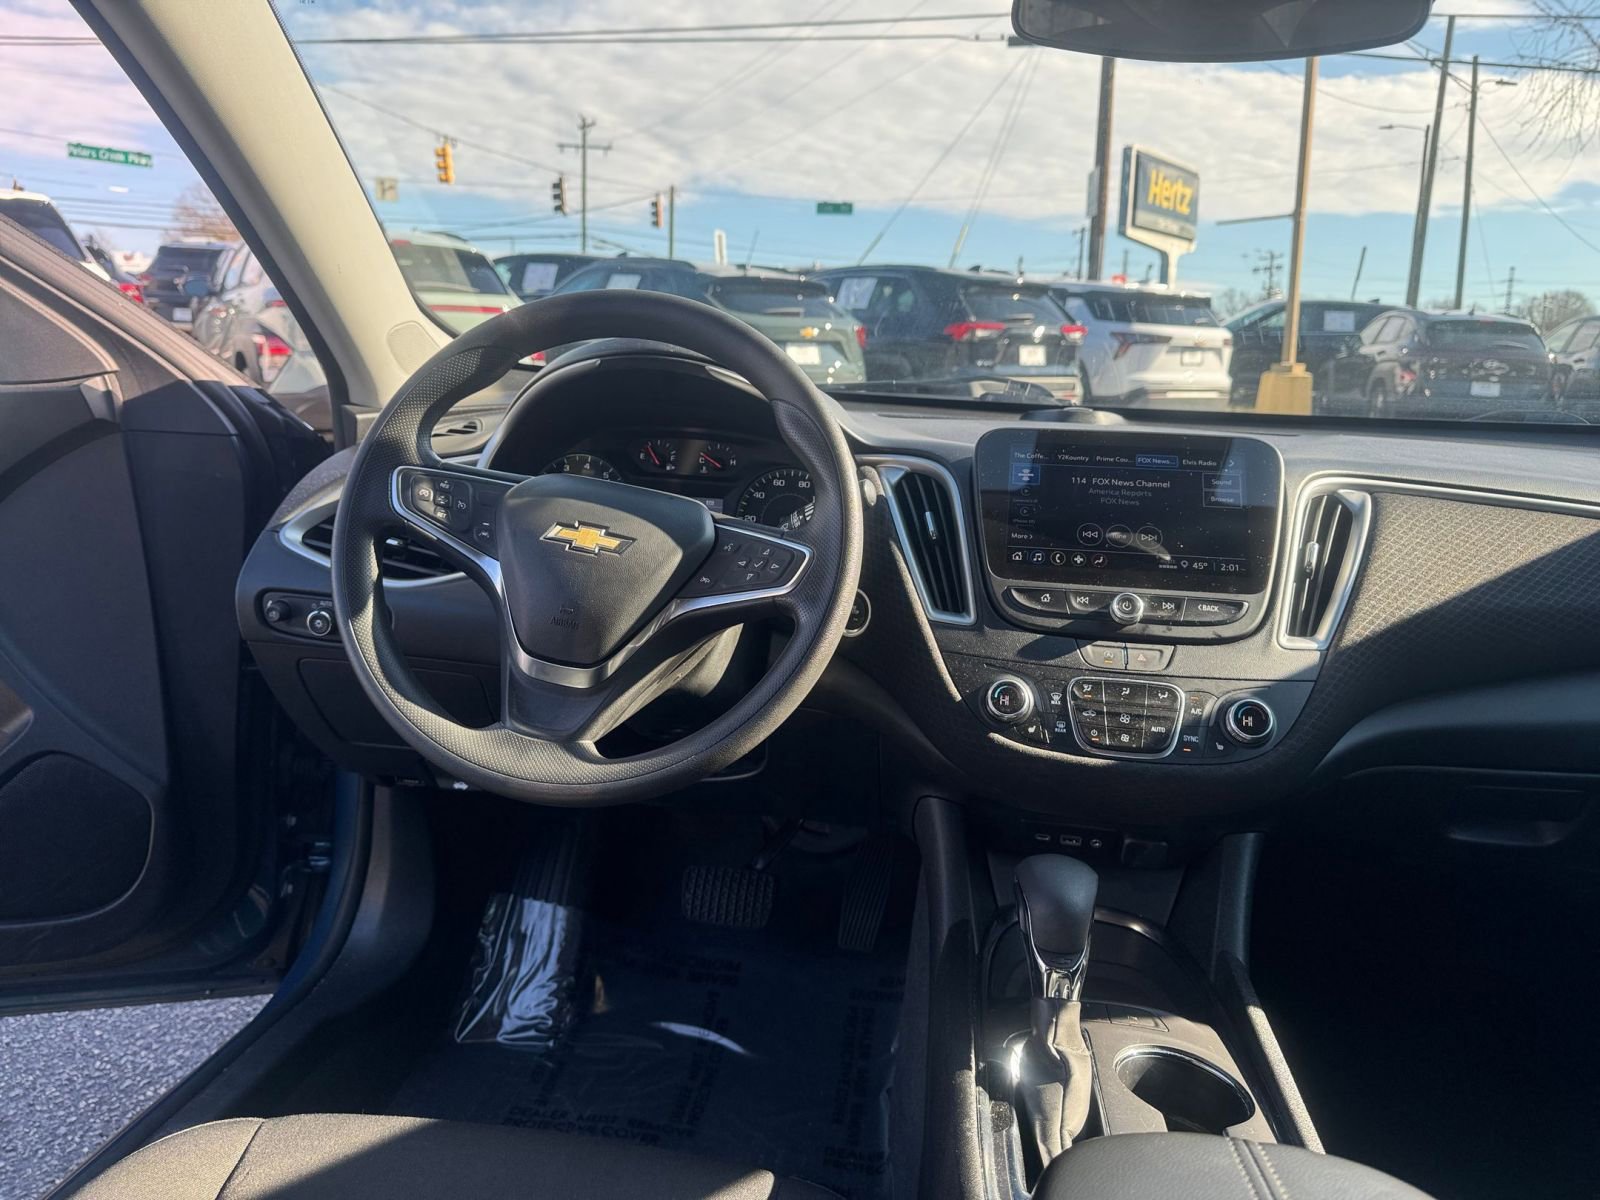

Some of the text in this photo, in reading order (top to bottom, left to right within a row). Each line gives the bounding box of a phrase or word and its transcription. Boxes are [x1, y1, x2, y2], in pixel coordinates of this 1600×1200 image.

[1148, 167, 1193, 215] Hertz
[1013, 451, 1025, 459] The
[1057, 453, 1090, 462] Y2Kountry
[1096, 455, 1113, 463] Prime
[584, 462, 590, 470] 4
[730, 458, 737, 466] H
[1198, 459, 1217, 467] Radio
[563, 464, 570, 472] 3
[772, 479, 786, 487] 60
[798, 481, 811, 489] 80
[1071, 476, 1171, 489] 114 FOX News Channel
[1211, 478, 1232, 486] Sound
[752, 492, 765, 500] 40
[1088, 488, 1153, 498] America Reports
[1100, 497, 1140, 506] FOX News
[744, 514, 757, 523] 20
[1011, 532, 1029, 540] More
[1220, 564, 1240, 572] 2:01
[1202, 604, 1220, 613] BACK
[999, 694, 1010, 706] HI
[1190, 707, 1203, 716] A/C
[1242, 715, 1254, 727] HI
[1150, 725, 1166, 734] AUTO
[1183, 734, 1199, 744] SYNC
